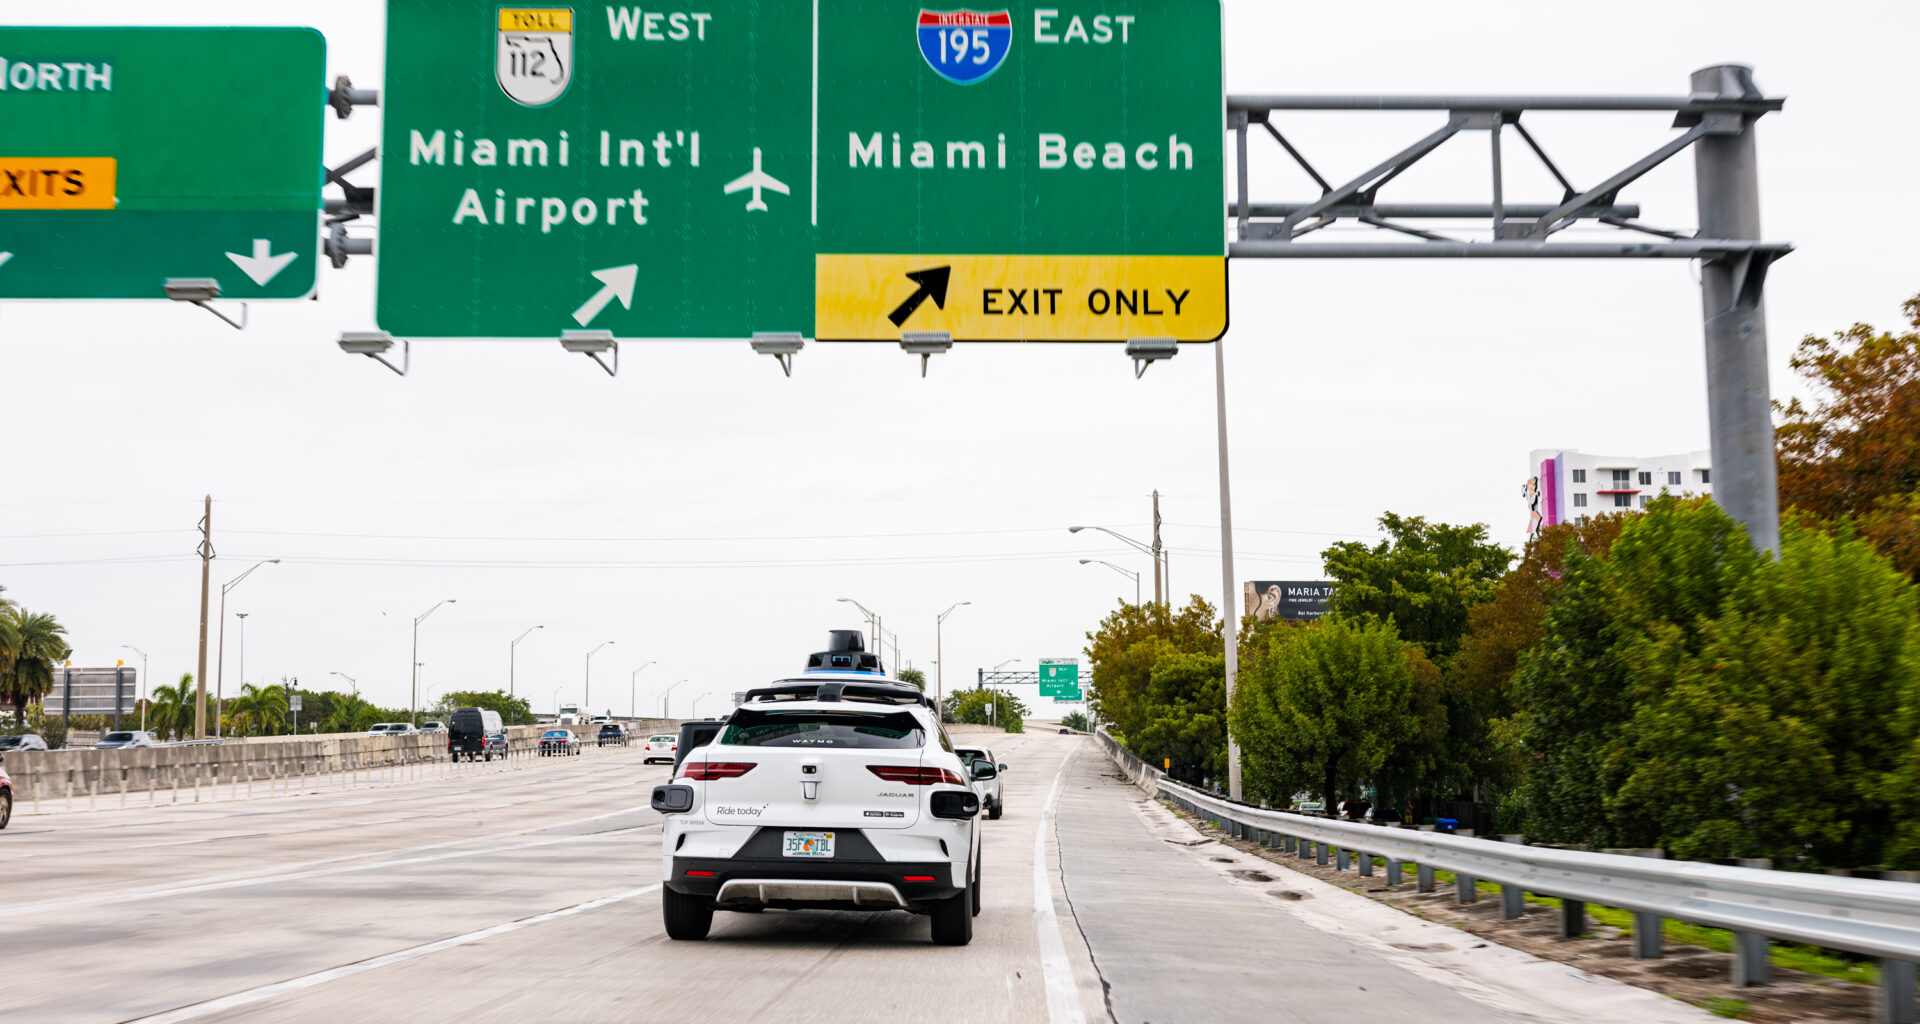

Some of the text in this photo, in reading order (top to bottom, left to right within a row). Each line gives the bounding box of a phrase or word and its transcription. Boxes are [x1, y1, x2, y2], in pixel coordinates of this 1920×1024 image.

[513, 13, 559, 29] TOLL
[606, 6, 712, 41] WEST
[938, 13, 990, 27] INTERSTATE
[1034, 9, 1135, 43] EAST
[939, 30, 990, 65] 195
[509, 50, 546, 78] 112
[410, 129, 700, 168] Miami Int'l
[849, 132, 1194, 171] Miami Beach
[0, 169, 86, 197] XITS
[452, 188, 650, 233] Airport
[982, 288, 1191, 315] EXIT ONLY
[1288, 587, 1320, 596] MARIA
[716, 806, 763, 818] Ride today
[786, 838, 831, 851] 35F TBL
